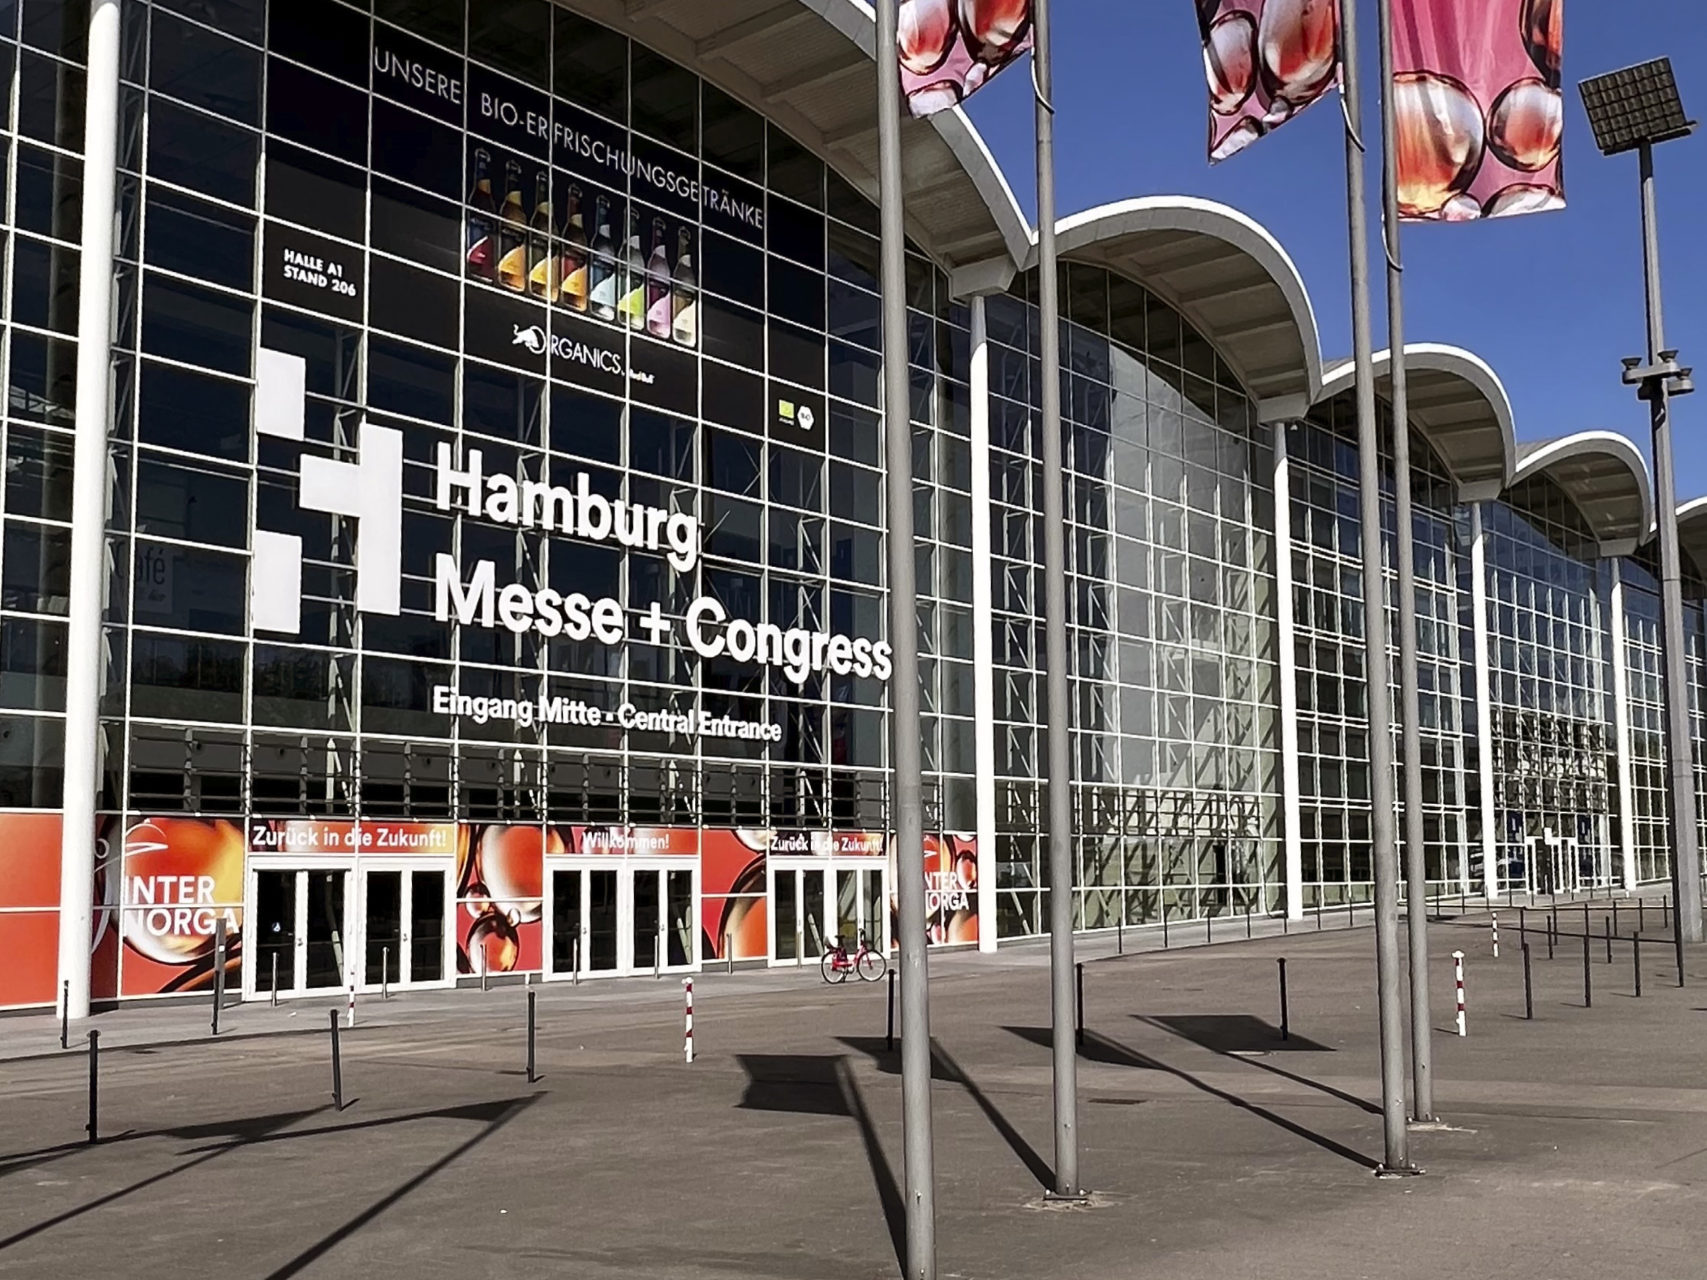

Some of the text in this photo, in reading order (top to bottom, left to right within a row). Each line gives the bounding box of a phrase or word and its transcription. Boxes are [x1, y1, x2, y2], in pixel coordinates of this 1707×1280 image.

[374, 46, 462, 105] UNSERE
[284, 248, 343, 278] HALLE A1
[283, 264, 357, 297] STAND 206
[436, 441, 698, 573] Hamburg
[434, 551, 893, 684] Messe + Congress
[432, 685, 534, 727] Eingang
[538, 696, 602, 727] Mitte
[616, 702, 695, 735] Central
[699, 710, 783, 742] Entrance
[252, 825, 447, 847] Zurück in die Zukunft!
[582, 830, 670, 850] Willkommen!
[123, 875, 216, 905] INTER
[924, 871, 958, 892] NTER
[926, 892, 970, 911] ORGA
[123, 907, 240, 937] NORGA
